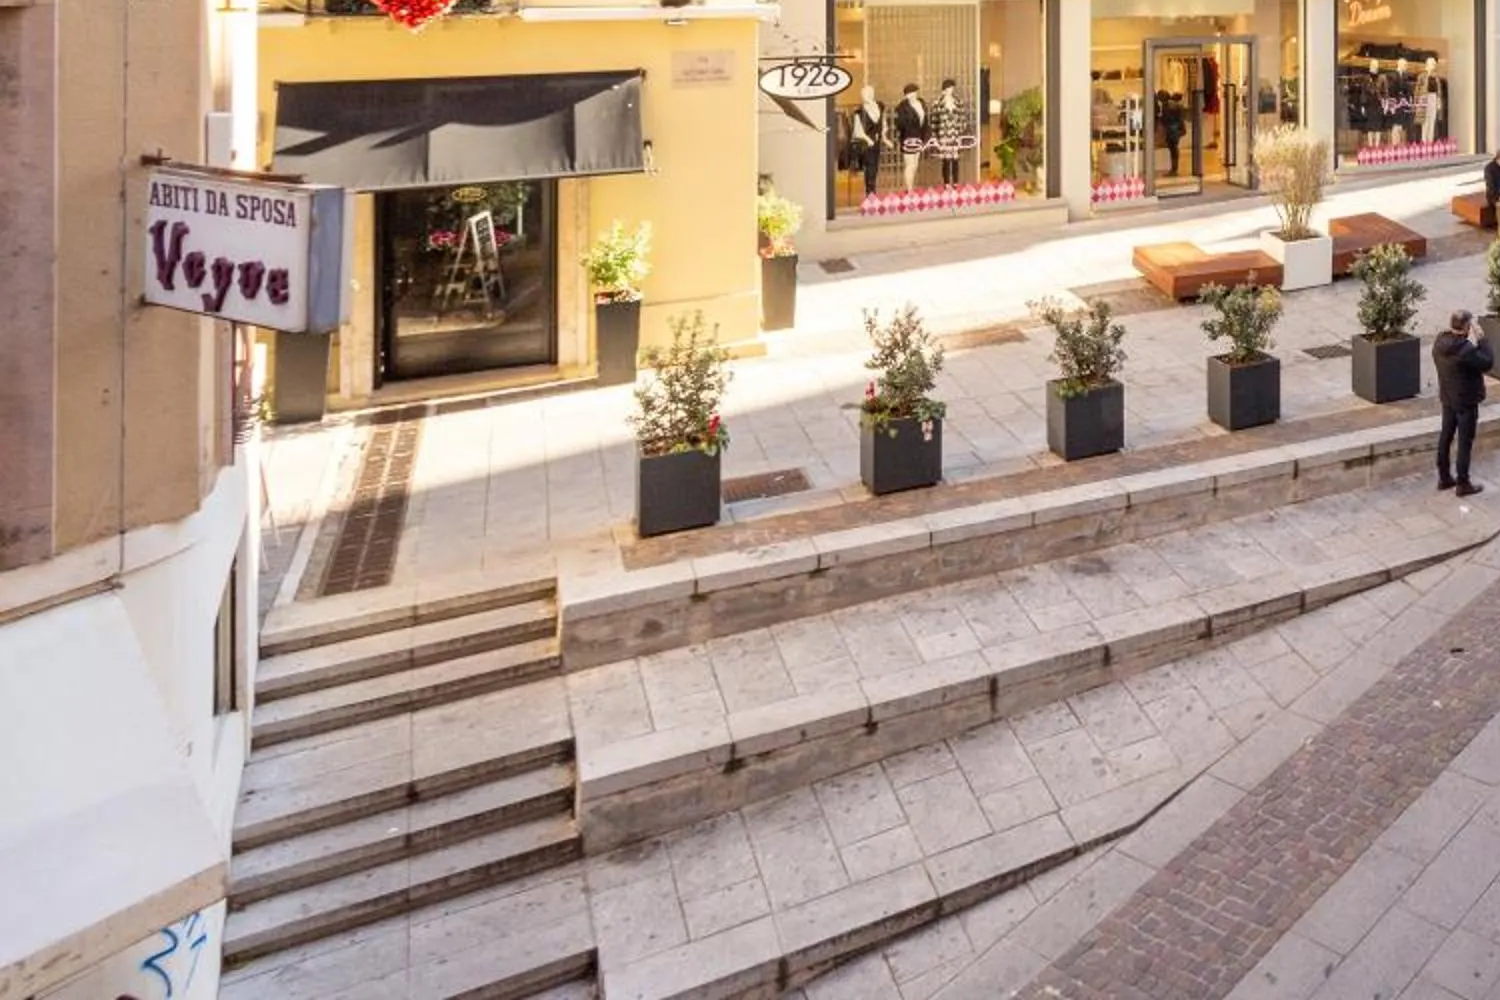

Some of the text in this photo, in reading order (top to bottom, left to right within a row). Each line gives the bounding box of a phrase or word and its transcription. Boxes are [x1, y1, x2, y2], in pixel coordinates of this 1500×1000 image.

[777, 66, 839, 88] 1926
[149, 181, 297, 228] ABITI DA SPOSA
